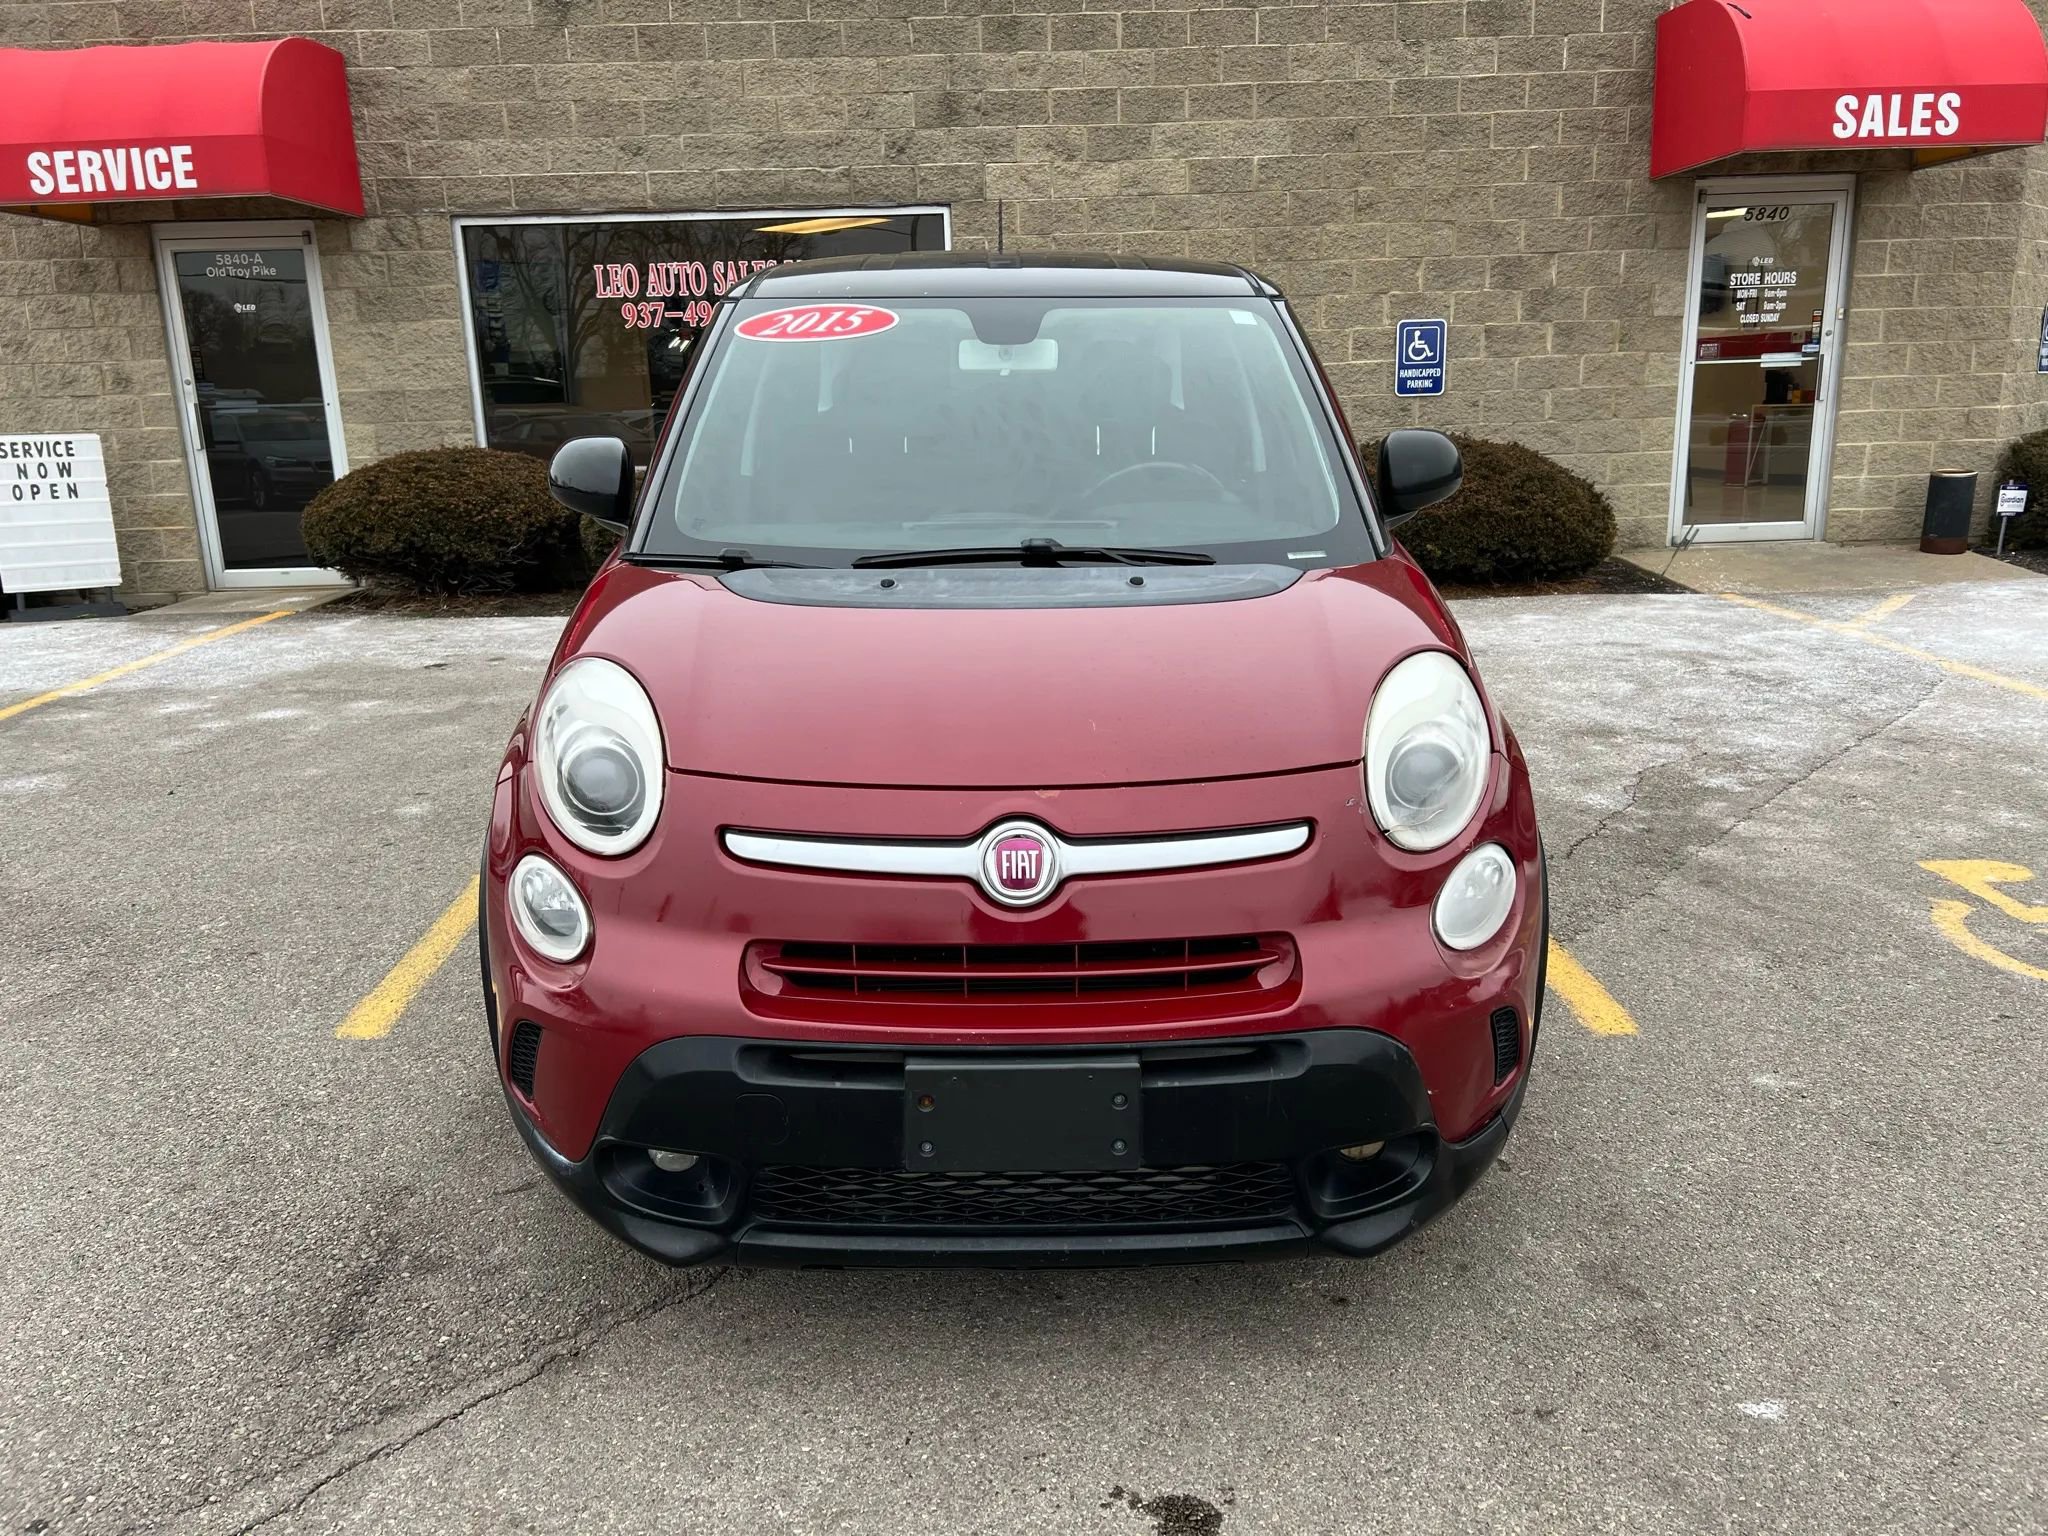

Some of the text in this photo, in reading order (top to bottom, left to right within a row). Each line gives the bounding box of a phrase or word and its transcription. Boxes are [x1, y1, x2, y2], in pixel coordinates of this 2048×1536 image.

[1832, 92, 1961, 139] SALES
[27, 145, 198, 195] SERVICE
[1744, 206, 1790, 221] 5840
[215, 253, 263, 265] 5840-A
[206, 265, 277, 278] Old Troy Pike
[594, 263, 640, 298] LEO
[646, 261, 707, 297] AUTO
[1730, 271, 1797, 285] STORE HOURS
[1736, 301, 1746, 311] SAT
[755, 309, 874, 336] 2015
[1740, 312, 1780, 323] CLOSED SUNDAY
[1400, 368, 1441, 378] HANDICAPPED
[1407, 379, 1433, 388] PARKING
[0, 441, 75, 459] SERVICE
[16, 461, 72, 480] NOW
[12, 482, 79, 501] OPEN
[1001, 850, 1039, 880] FIAT
